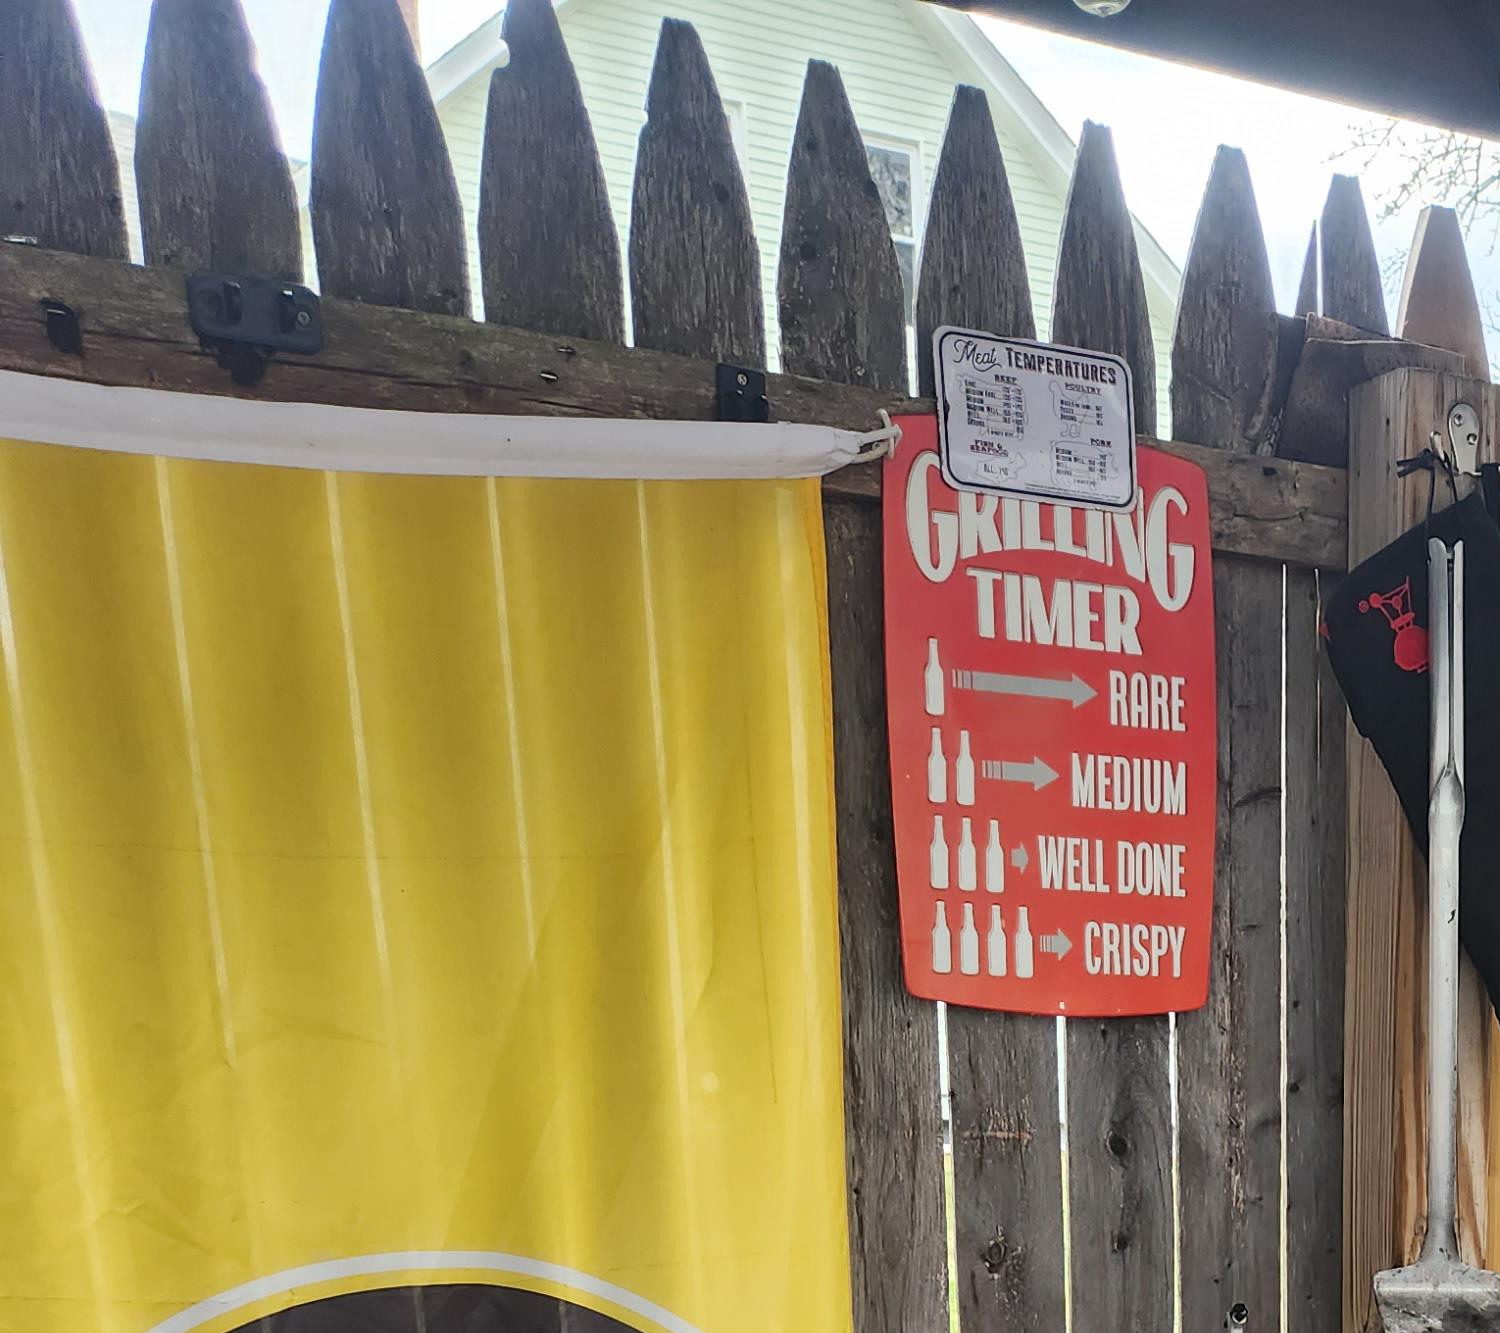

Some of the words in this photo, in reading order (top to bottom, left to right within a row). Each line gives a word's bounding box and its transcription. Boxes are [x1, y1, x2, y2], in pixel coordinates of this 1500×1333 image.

[953, 339, 1002, 372] Meat
[1005, 347, 1116, 385] TEMPERATURES
[906, 450, 1195, 612] GRILLING
[966, 567, 1143, 656] TIMER
[1108, 670, 1186, 732] RARE
[1071, 752, 1187, 816] MEDIUM
[1037, 835, 1110, 894] WELL
[1117, 840, 1187, 897] DONE
[1083, 920, 1186, 978] CRISPY
